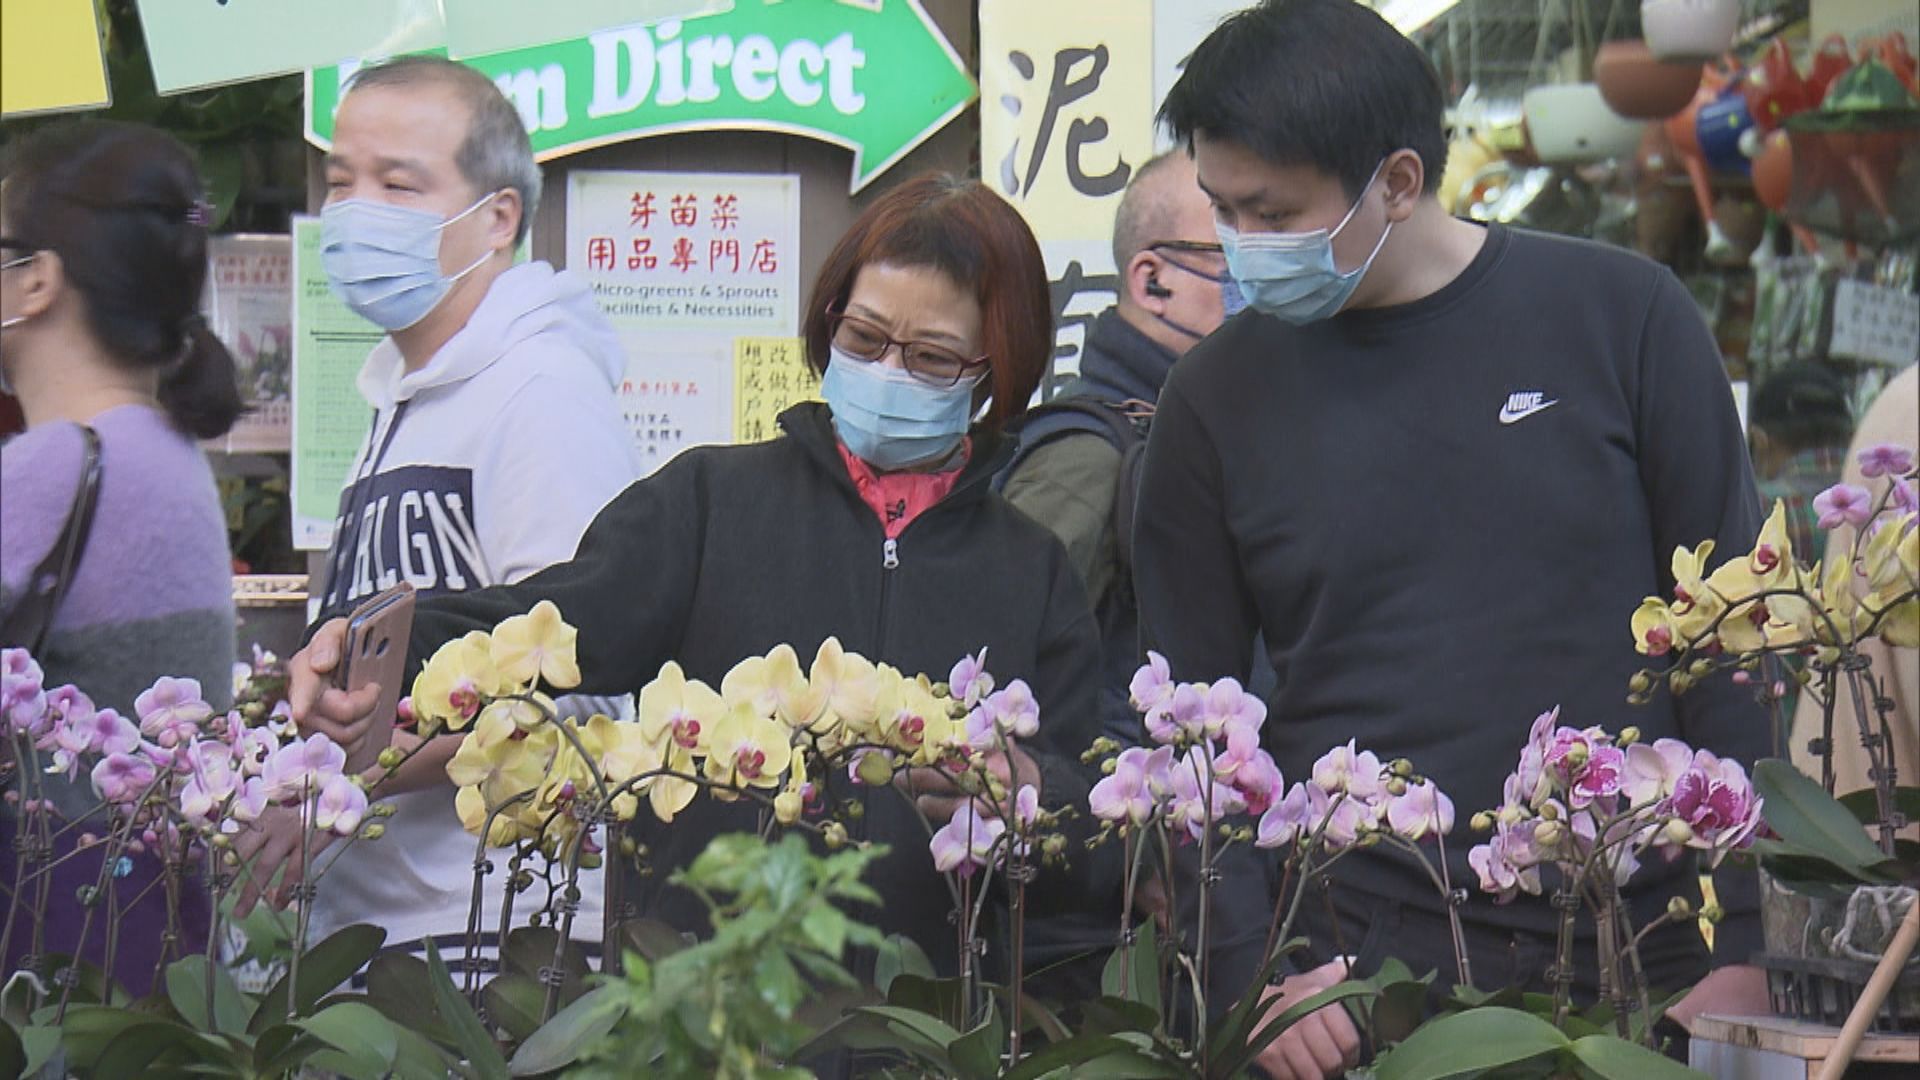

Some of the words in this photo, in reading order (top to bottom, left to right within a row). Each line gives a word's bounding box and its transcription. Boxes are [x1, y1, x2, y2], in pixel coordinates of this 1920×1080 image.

[586, 19, 867, 118] Direct
[630, 191, 740, 231] 芽苗菜
[587, 236, 778, 273] 用品專門店
[700, 284, 712, 297] &
[716, 283, 779, 300] Sprouts
[597, 302, 662, 317] acilities
[667, 304, 680, 317] &
[684, 303, 775, 317] Necessities
[1507, 391, 1544, 412] NIKE
